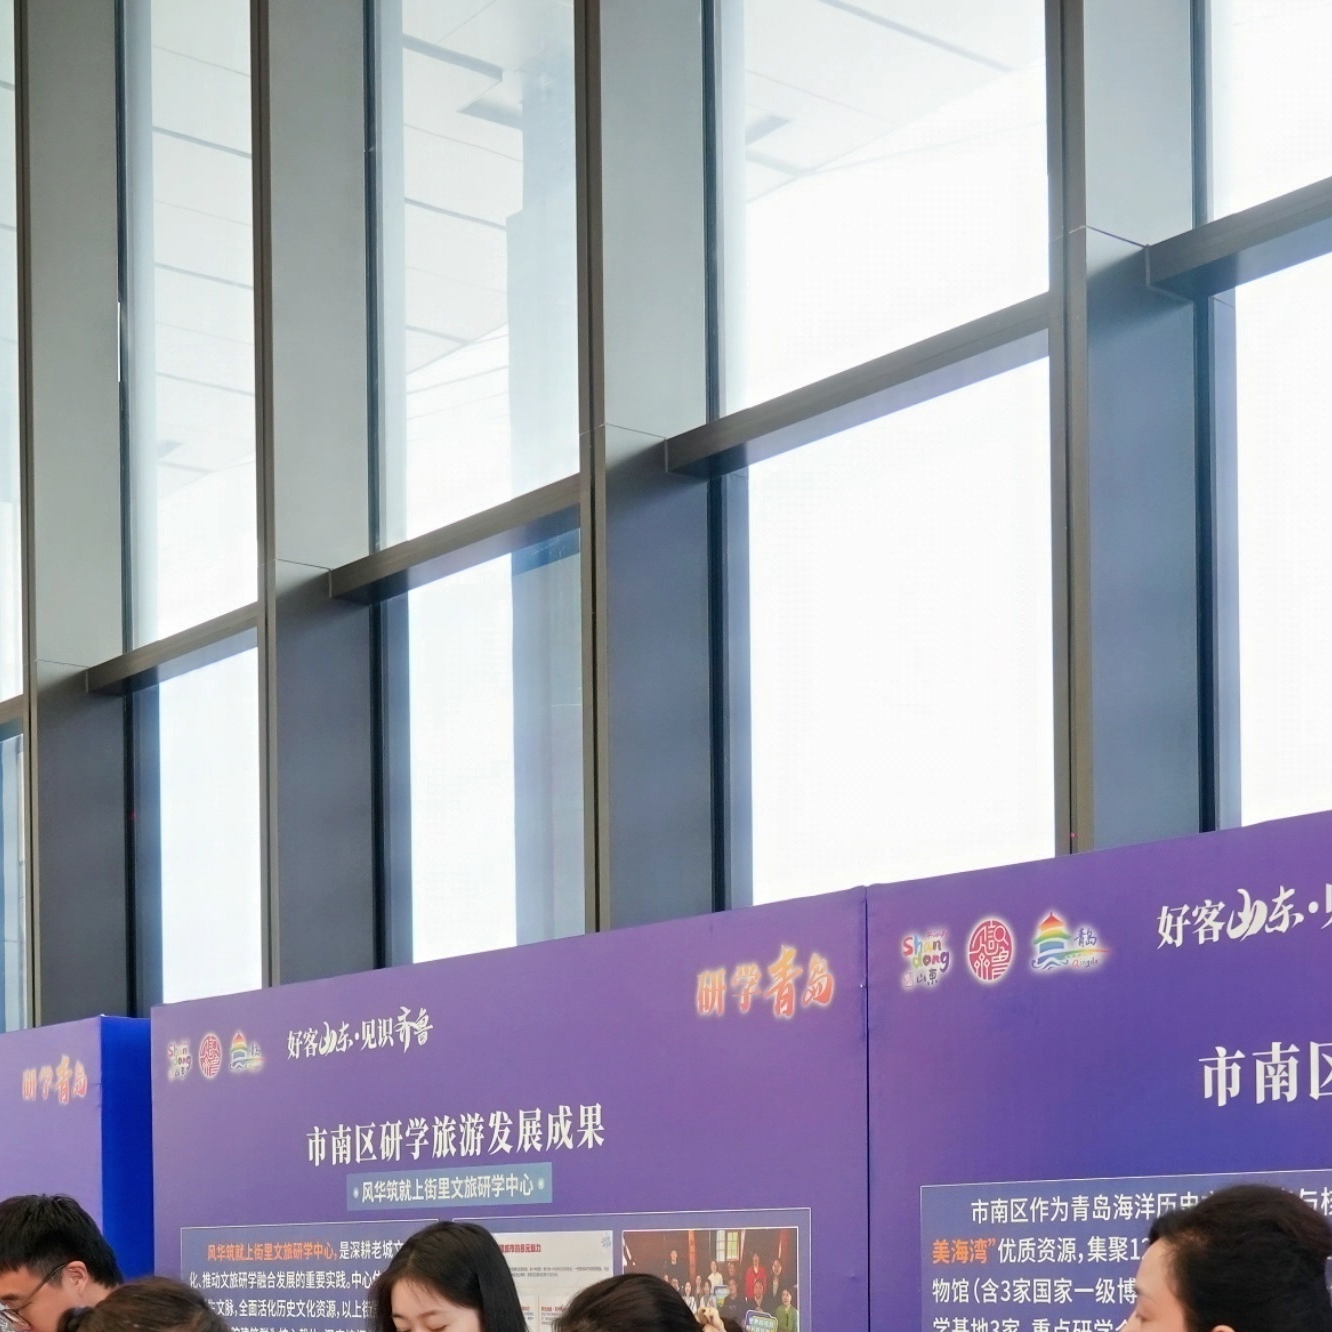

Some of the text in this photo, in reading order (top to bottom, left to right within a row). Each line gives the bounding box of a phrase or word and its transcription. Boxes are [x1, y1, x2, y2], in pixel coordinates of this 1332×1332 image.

[696, 945, 835, 1018] 研学青岛
[287, 1006, 434, 1060] 好客山东·见识齐鲁
[306, 1102, 605, 1167] 市南区研学旅游发展成果
[361, 1173, 534, 1203] 风华筑就上街里文旅研学中心
